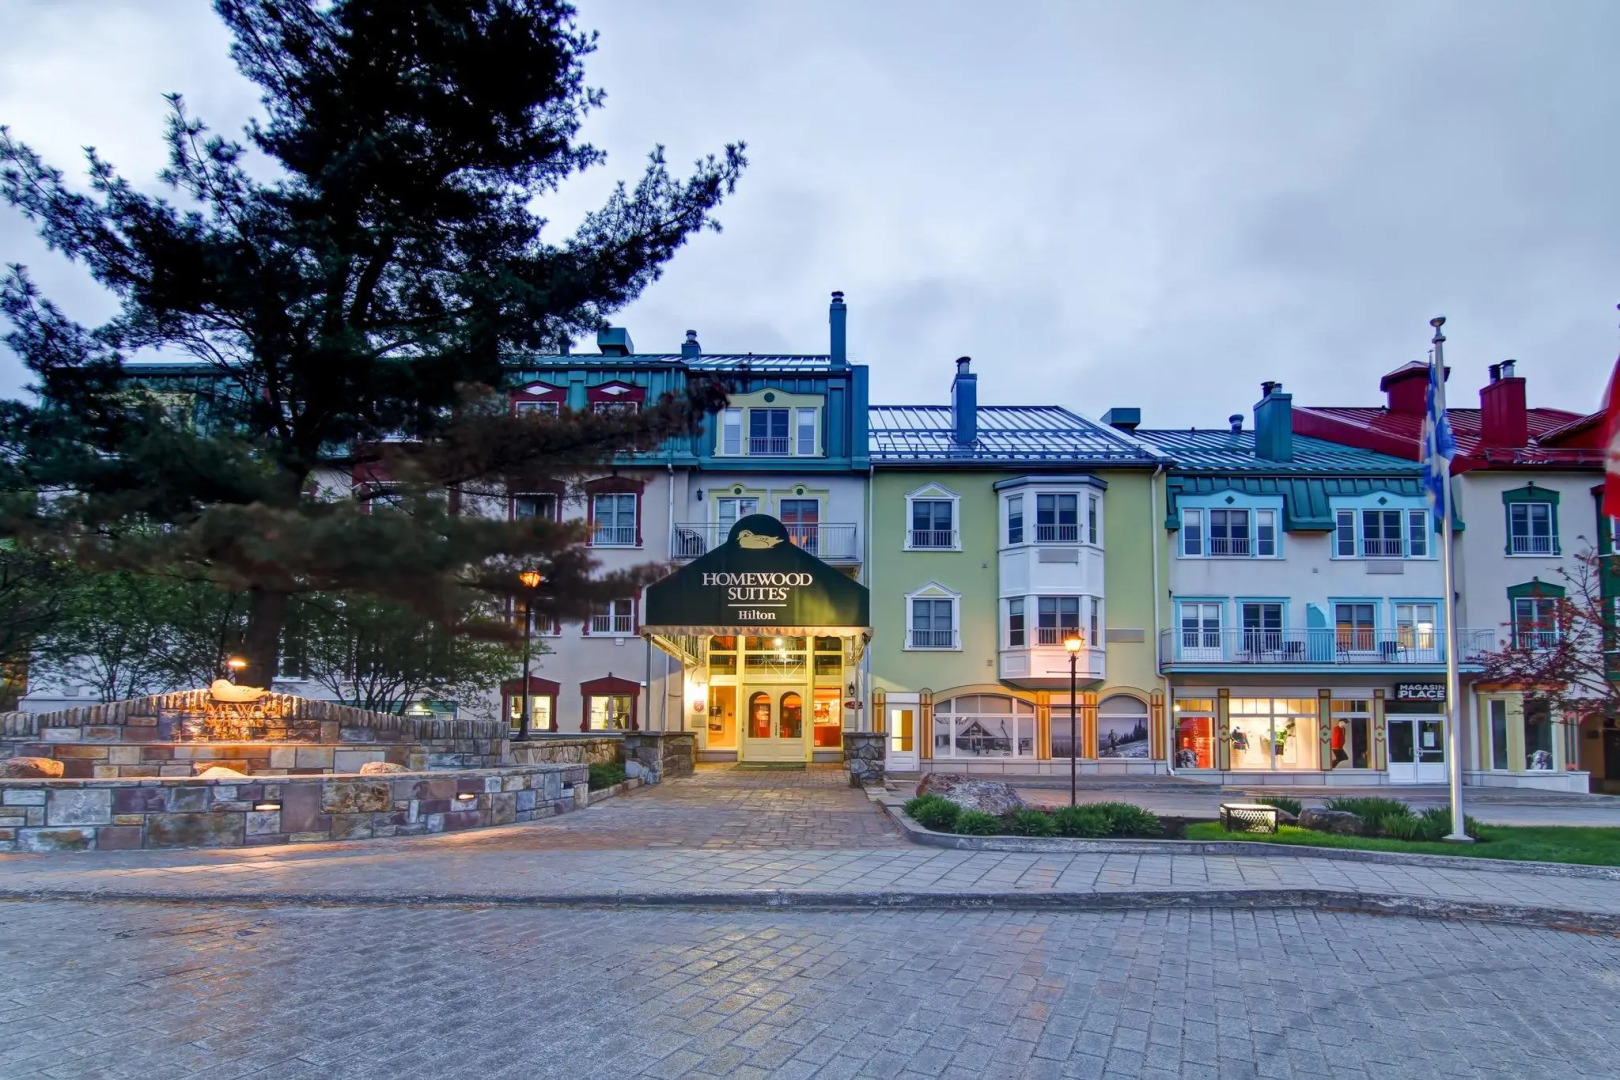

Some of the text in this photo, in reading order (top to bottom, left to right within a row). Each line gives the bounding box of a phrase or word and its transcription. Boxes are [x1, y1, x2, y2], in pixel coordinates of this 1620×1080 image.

[702, 573, 814, 586] HOMEWOOD
[728, 587, 788, 601] SUITES
[738, 610, 776, 620] Hilton
[1400, 690, 1445, 698] PLACE
